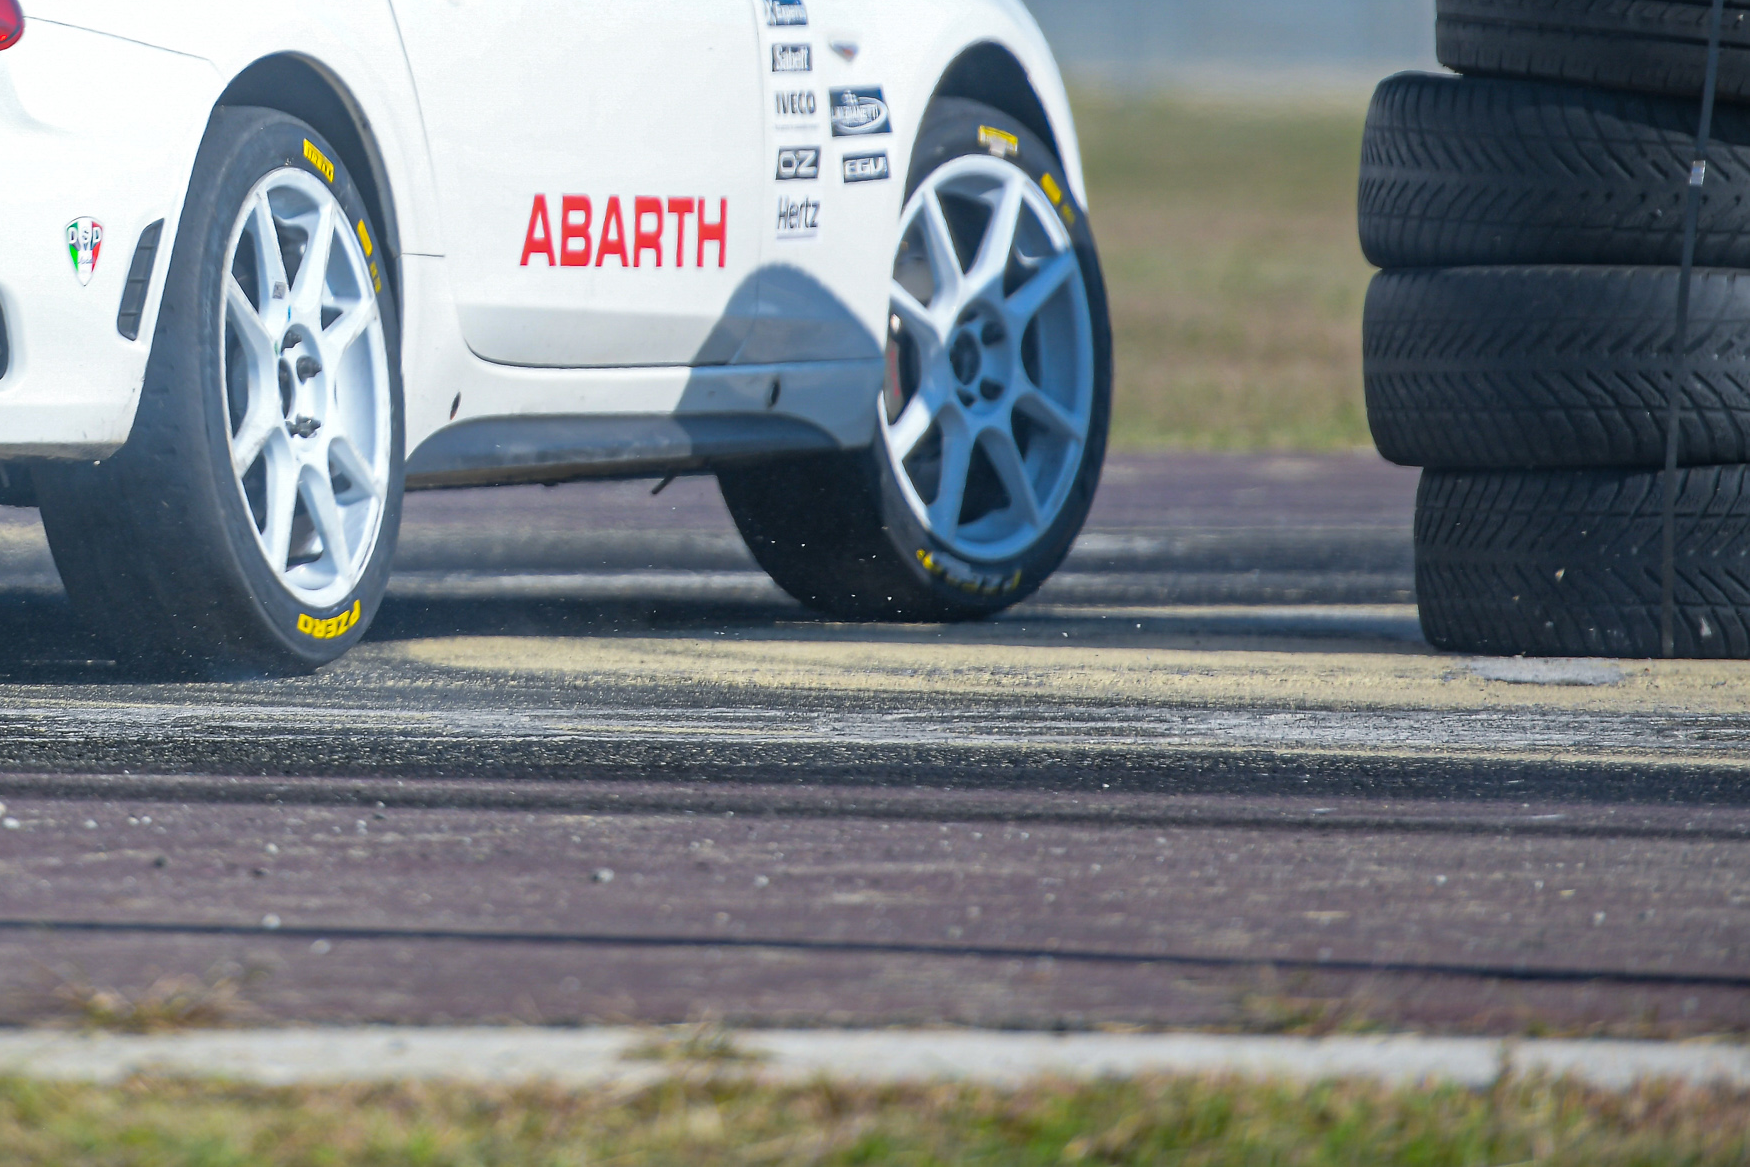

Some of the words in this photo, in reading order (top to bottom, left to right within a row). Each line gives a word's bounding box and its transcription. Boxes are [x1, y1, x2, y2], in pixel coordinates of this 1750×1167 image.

[775, 90, 817, 115] IVECO
[778, 149, 818, 177] OZ
[777, 195, 820, 229] Hertz
[519, 193, 727, 268] ABARTH
